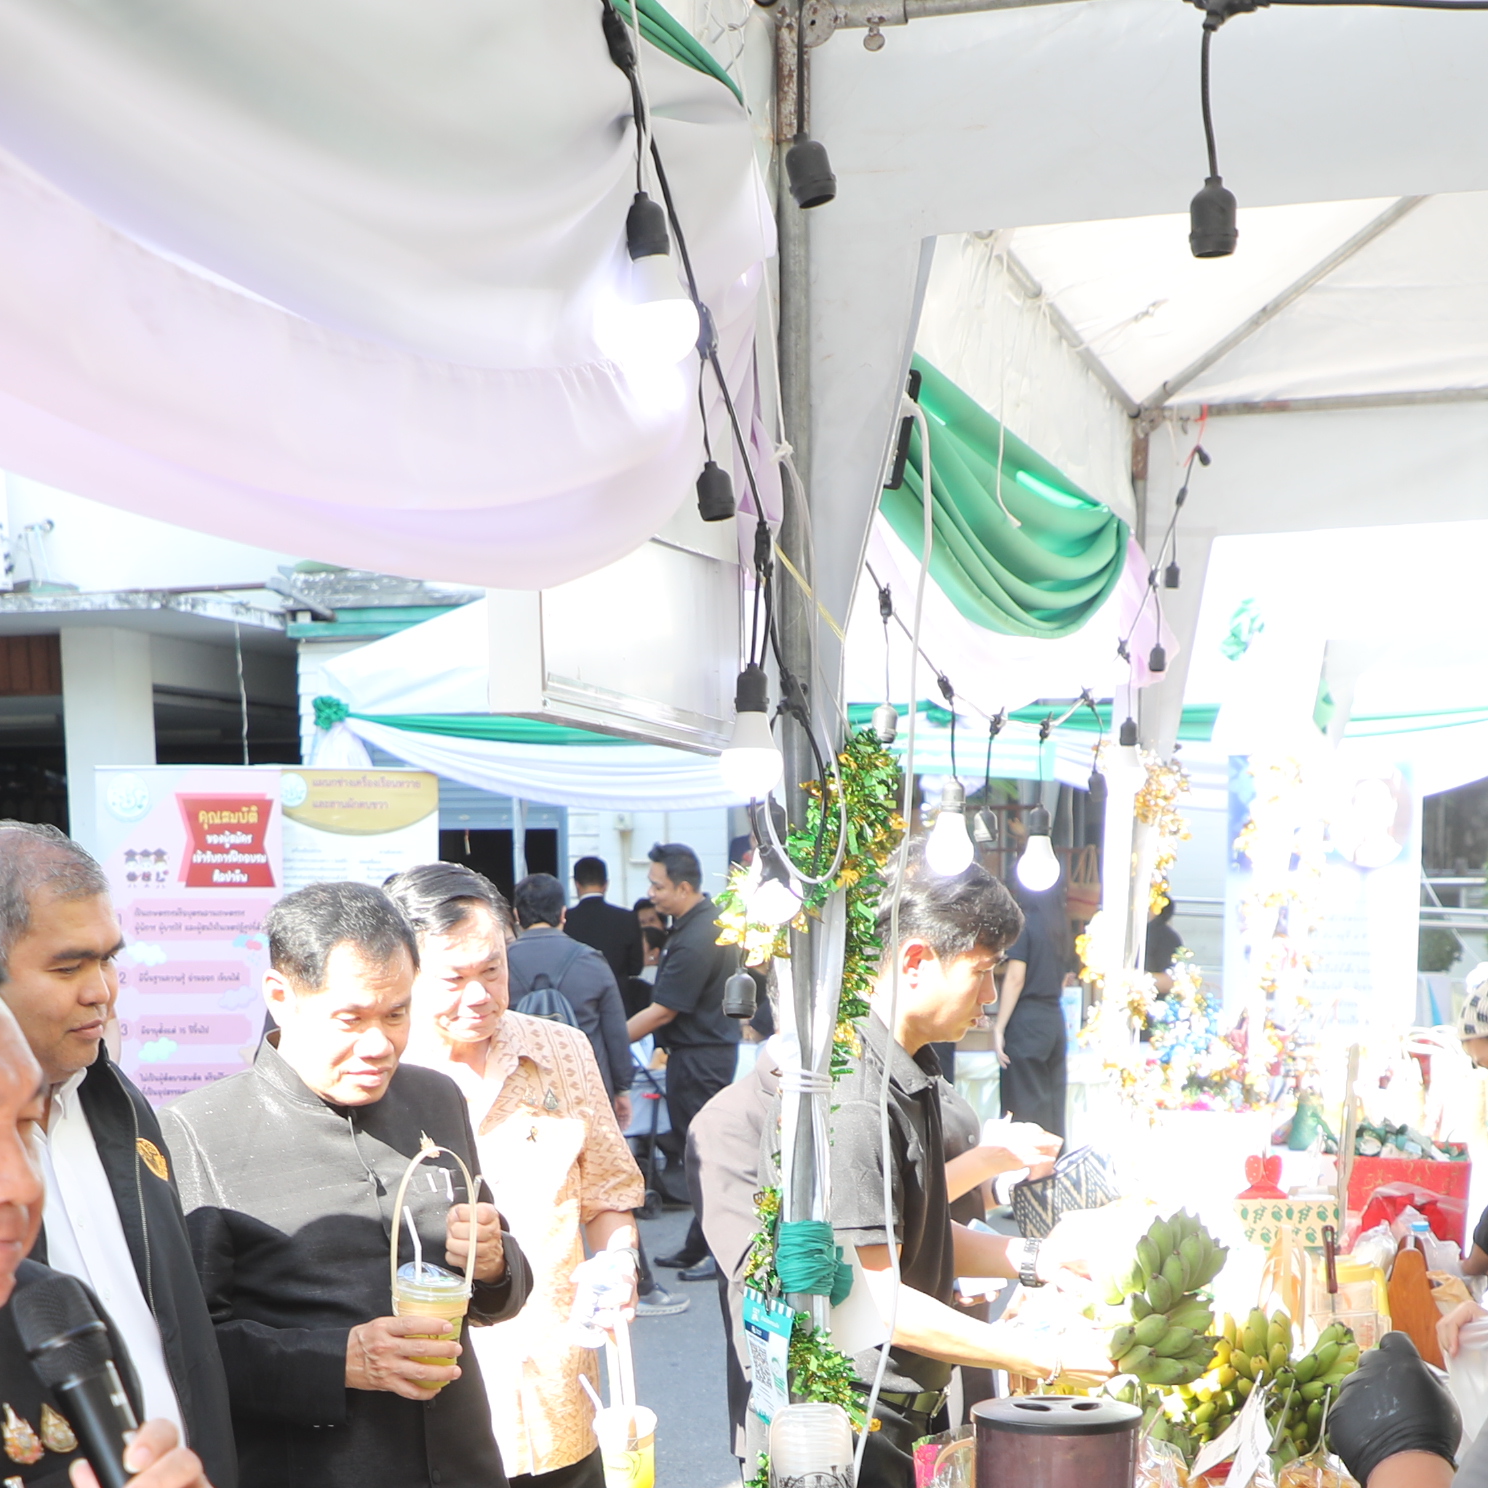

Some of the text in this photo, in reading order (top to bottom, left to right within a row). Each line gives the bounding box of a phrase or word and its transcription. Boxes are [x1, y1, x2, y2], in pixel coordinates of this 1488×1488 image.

[198, 805, 259, 830] คุณสมบัติ
[205, 830, 253, 849] ของผู้สมัคร
[192, 849, 268, 864] เข้ารับการฝึกอบรม
[212, 868, 249, 883] ศิลปาชีพ
[118, 971, 127, 984] 2
[120, 1023, 128, 1036] 3
